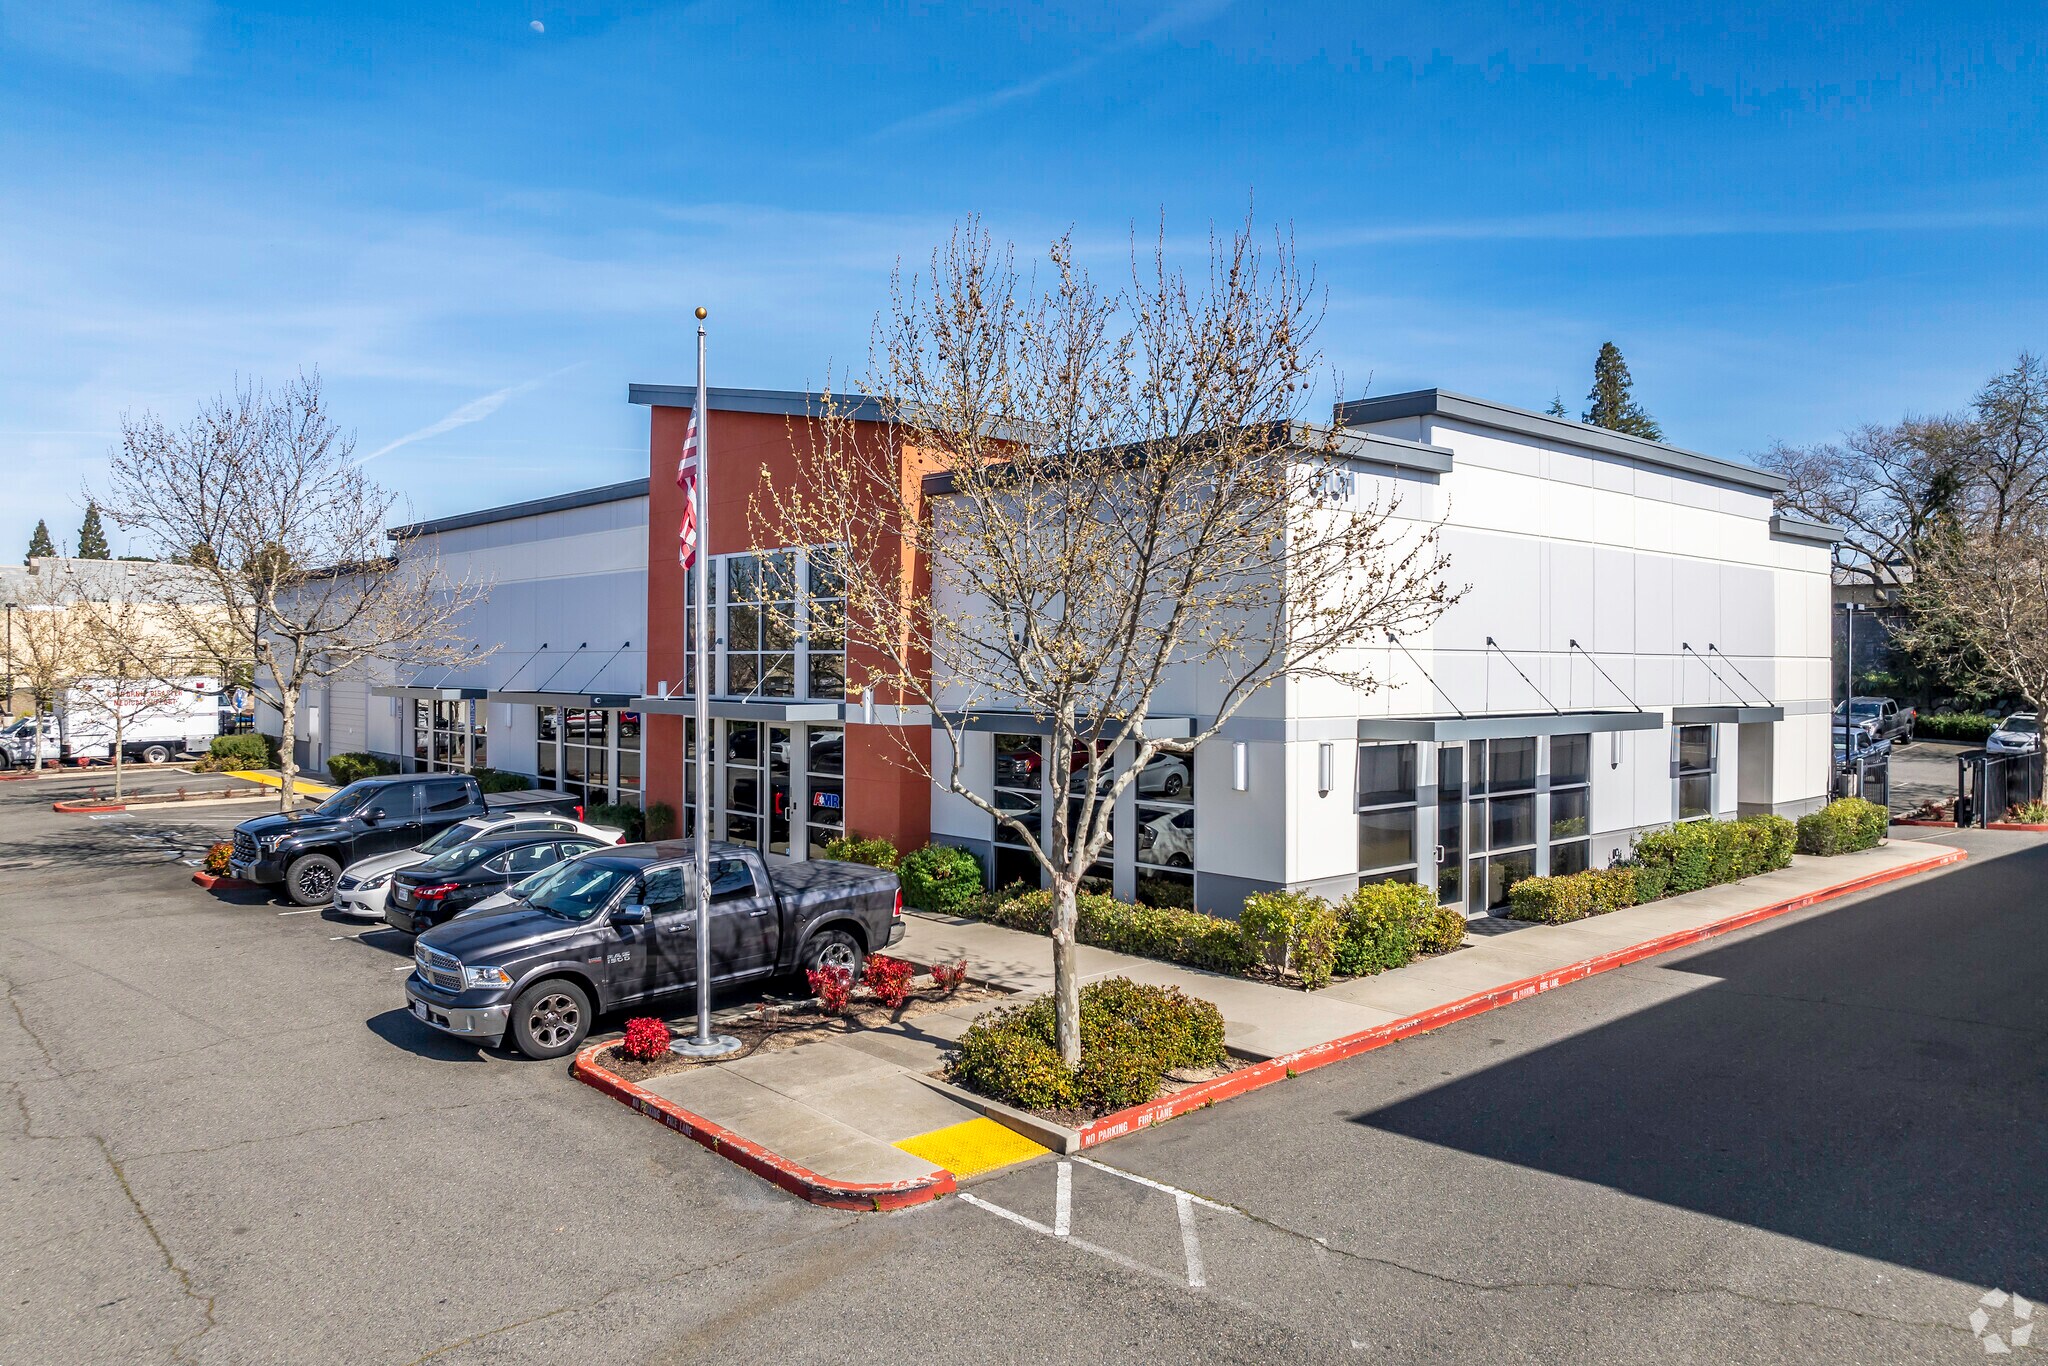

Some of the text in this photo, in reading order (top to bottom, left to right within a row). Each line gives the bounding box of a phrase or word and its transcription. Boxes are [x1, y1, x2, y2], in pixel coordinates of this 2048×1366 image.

[813, 792, 840, 809] AMR
[666, 1114, 678, 1128] FIRE
[680, 1121, 692, 1137] LANE
[1085, 1107, 1173, 1145] NO PARKING FIRE LANE
